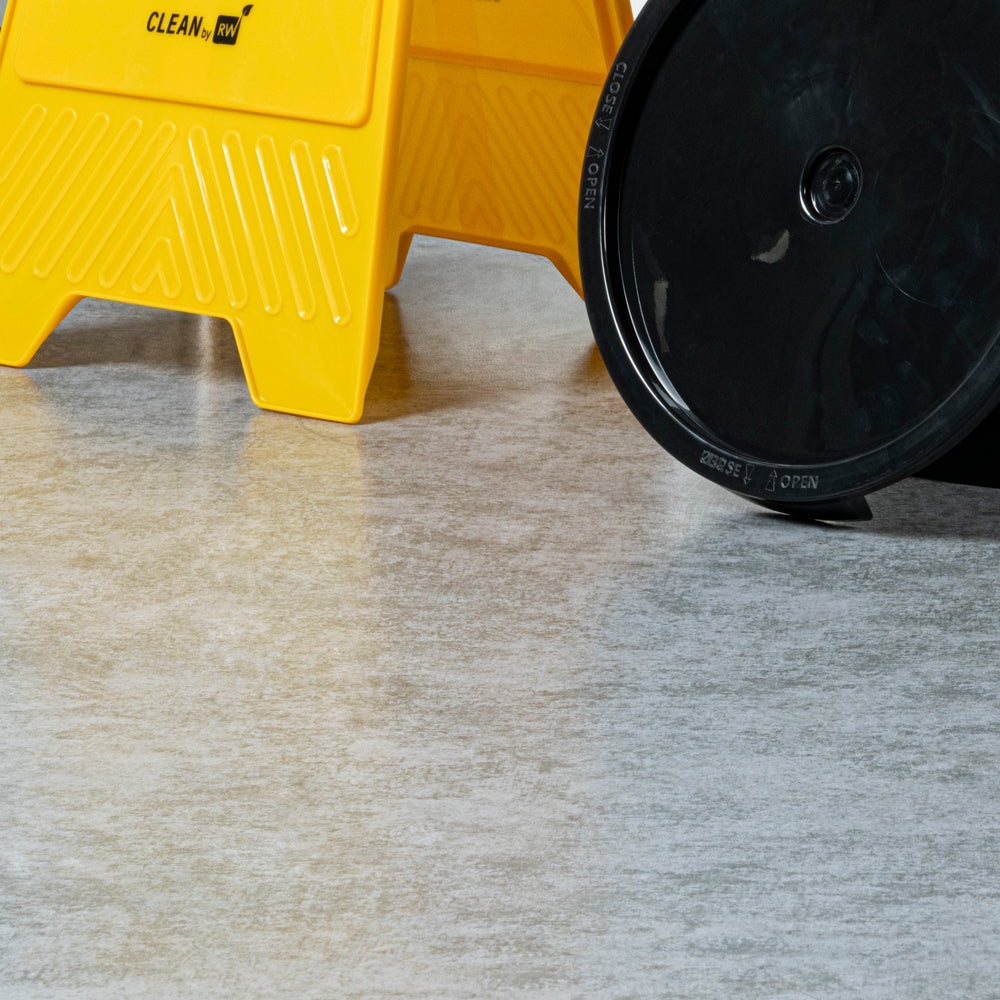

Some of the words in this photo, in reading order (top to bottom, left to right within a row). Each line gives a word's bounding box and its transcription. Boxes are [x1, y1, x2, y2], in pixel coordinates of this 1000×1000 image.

[146, 11, 203, 37] CLEAN
[201, 27, 212, 41] by
[602, 62, 628, 114] CLOSE
[583, 162, 600, 209] OPEN
[780, 475, 819, 489] OPEN
